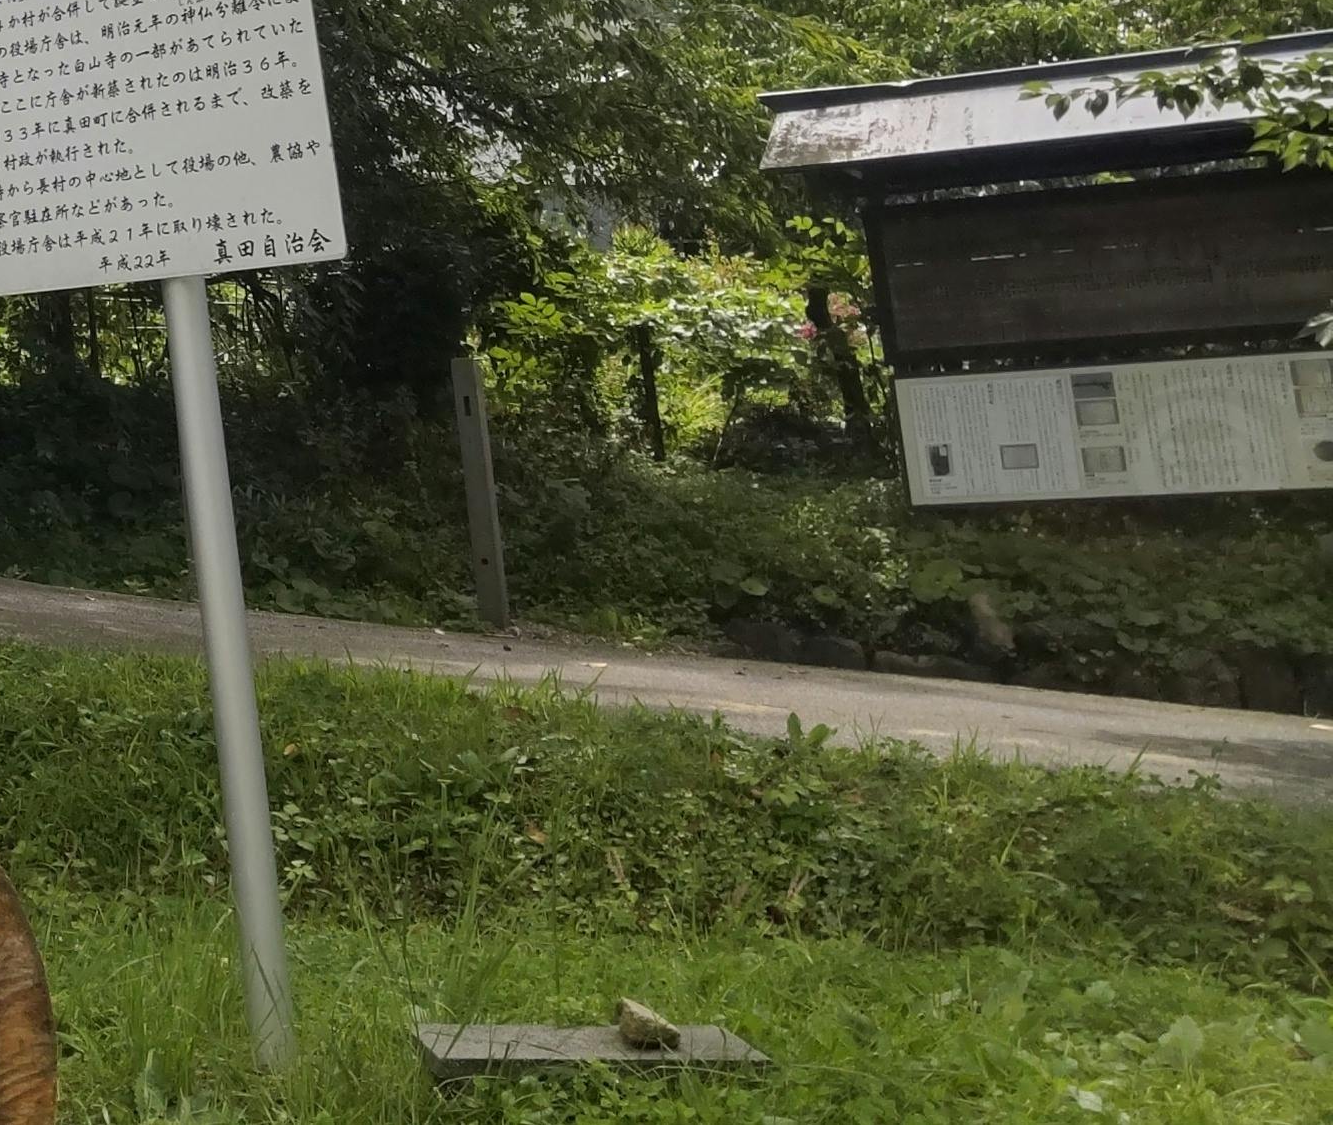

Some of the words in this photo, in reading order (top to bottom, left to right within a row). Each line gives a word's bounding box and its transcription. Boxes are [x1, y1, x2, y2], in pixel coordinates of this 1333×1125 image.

[97, 249, 172, 273] 平成22年
[213, 227, 333, 266] 真田自治会
